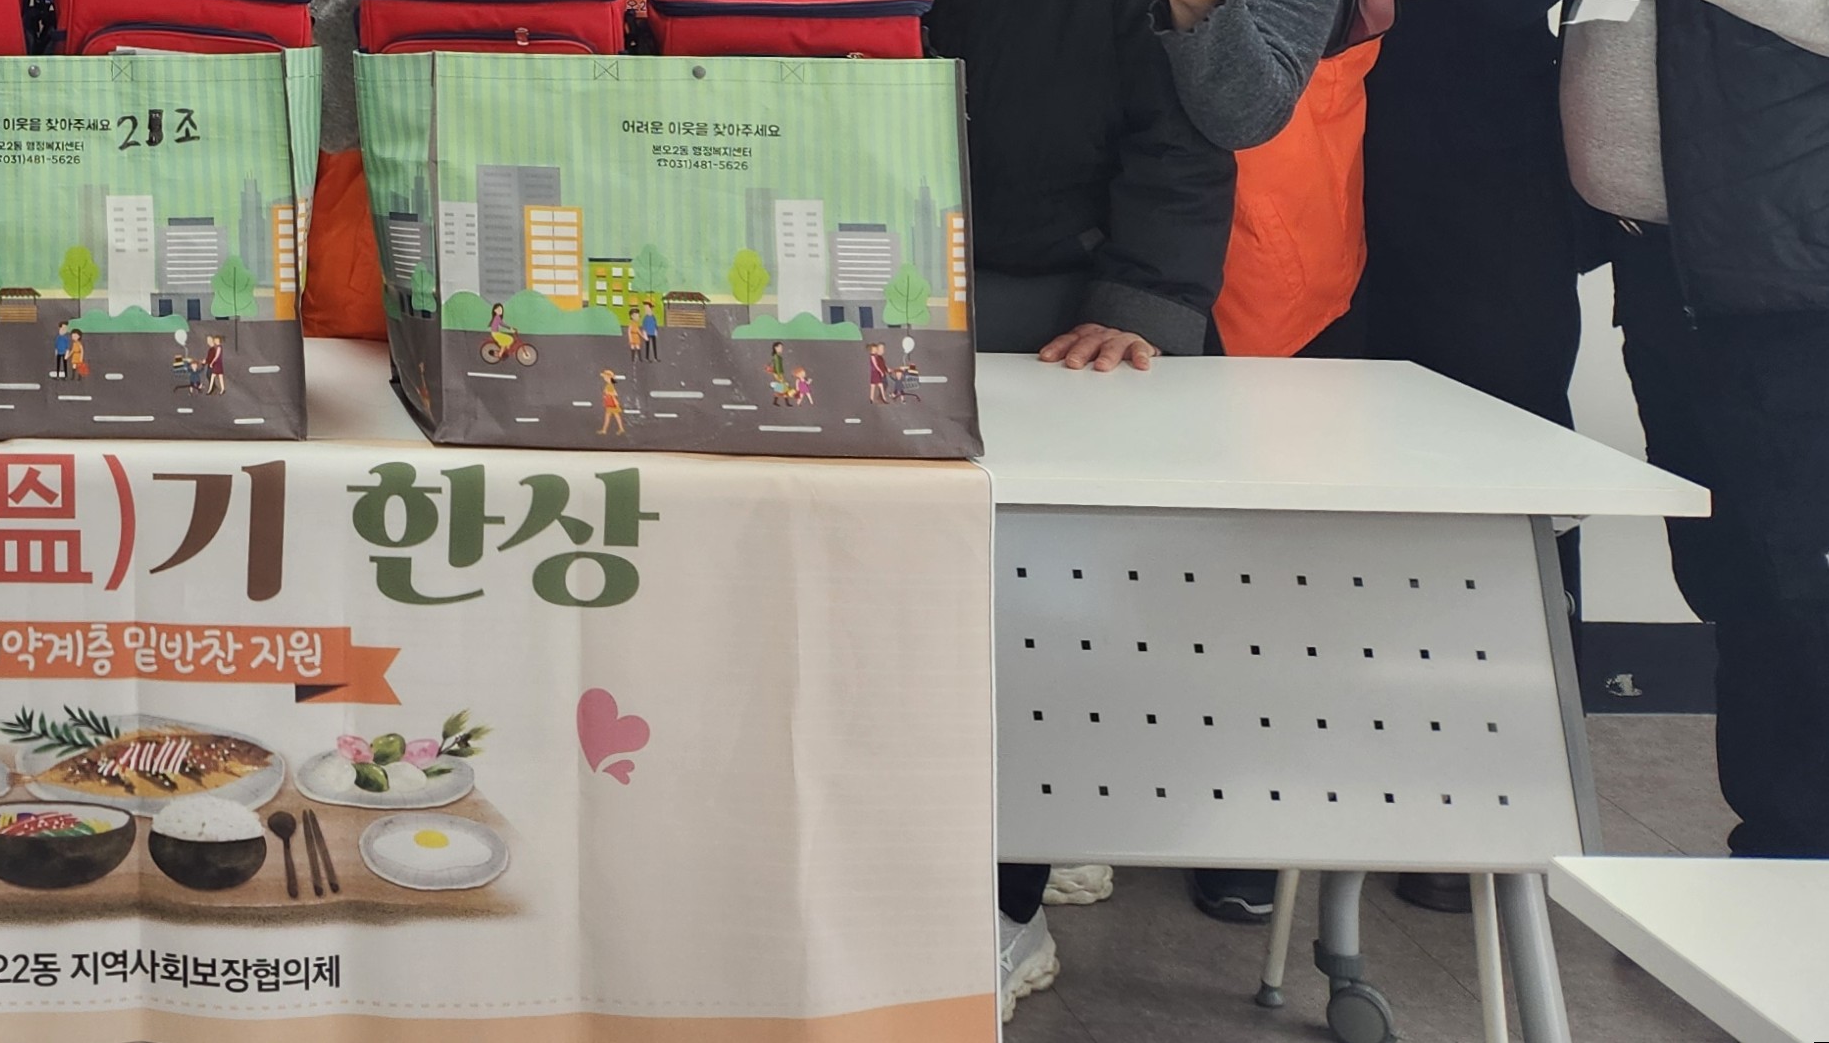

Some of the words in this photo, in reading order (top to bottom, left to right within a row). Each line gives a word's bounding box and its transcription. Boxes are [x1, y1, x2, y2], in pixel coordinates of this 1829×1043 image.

[3, 117, 41, 132] 이웃을
[45, 117, 112, 132] 찾아주세요
[622, 120, 663, 135] 어려운
[668, 121, 709, 137] 이웃을
[713, 123, 782, 138] 찾아주세요
[26, 140, 85, 153] 행정복지센터
[651, 144, 689, 156] 본오2동
[692, 145, 752, 158] 행정복지센터
[345, 461, 660, 609] 한상
[123, 627, 245, 676] 밑반찬
[251, 630, 323, 678] 지원
[70, 949, 341, 993] 지역사회보장협의체
